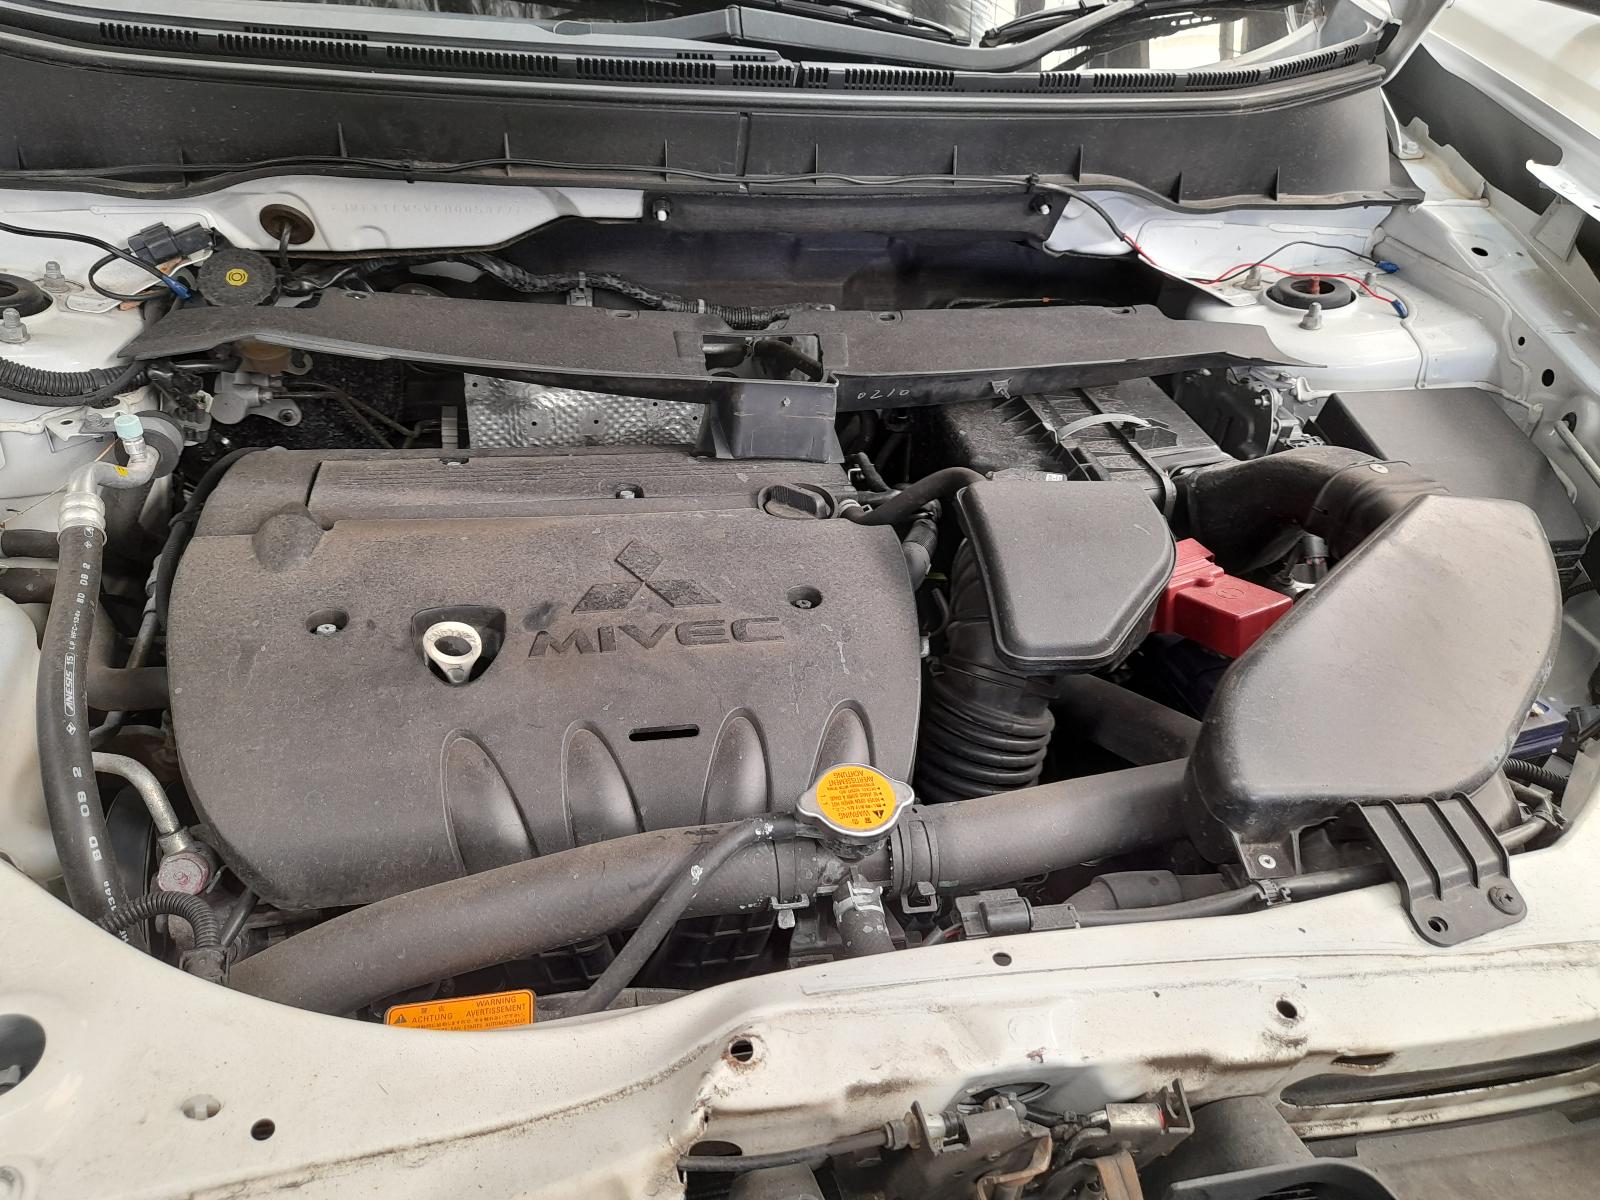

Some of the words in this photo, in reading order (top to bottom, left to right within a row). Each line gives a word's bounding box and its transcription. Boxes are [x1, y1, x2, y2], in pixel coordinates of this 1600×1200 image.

[857, 388, 910, 399] 0210
[528, 616, 785, 658] MIVEC
[833, 770, 864, 779] ACHTUNG
[838, 810, 870, 819] WARNING
[476, 996, 517, 1007] WARNING
[465, 1004, 526, 1018] AVERTISSEMENT
[411, 1013, 453, 1024] ACHTUNG
